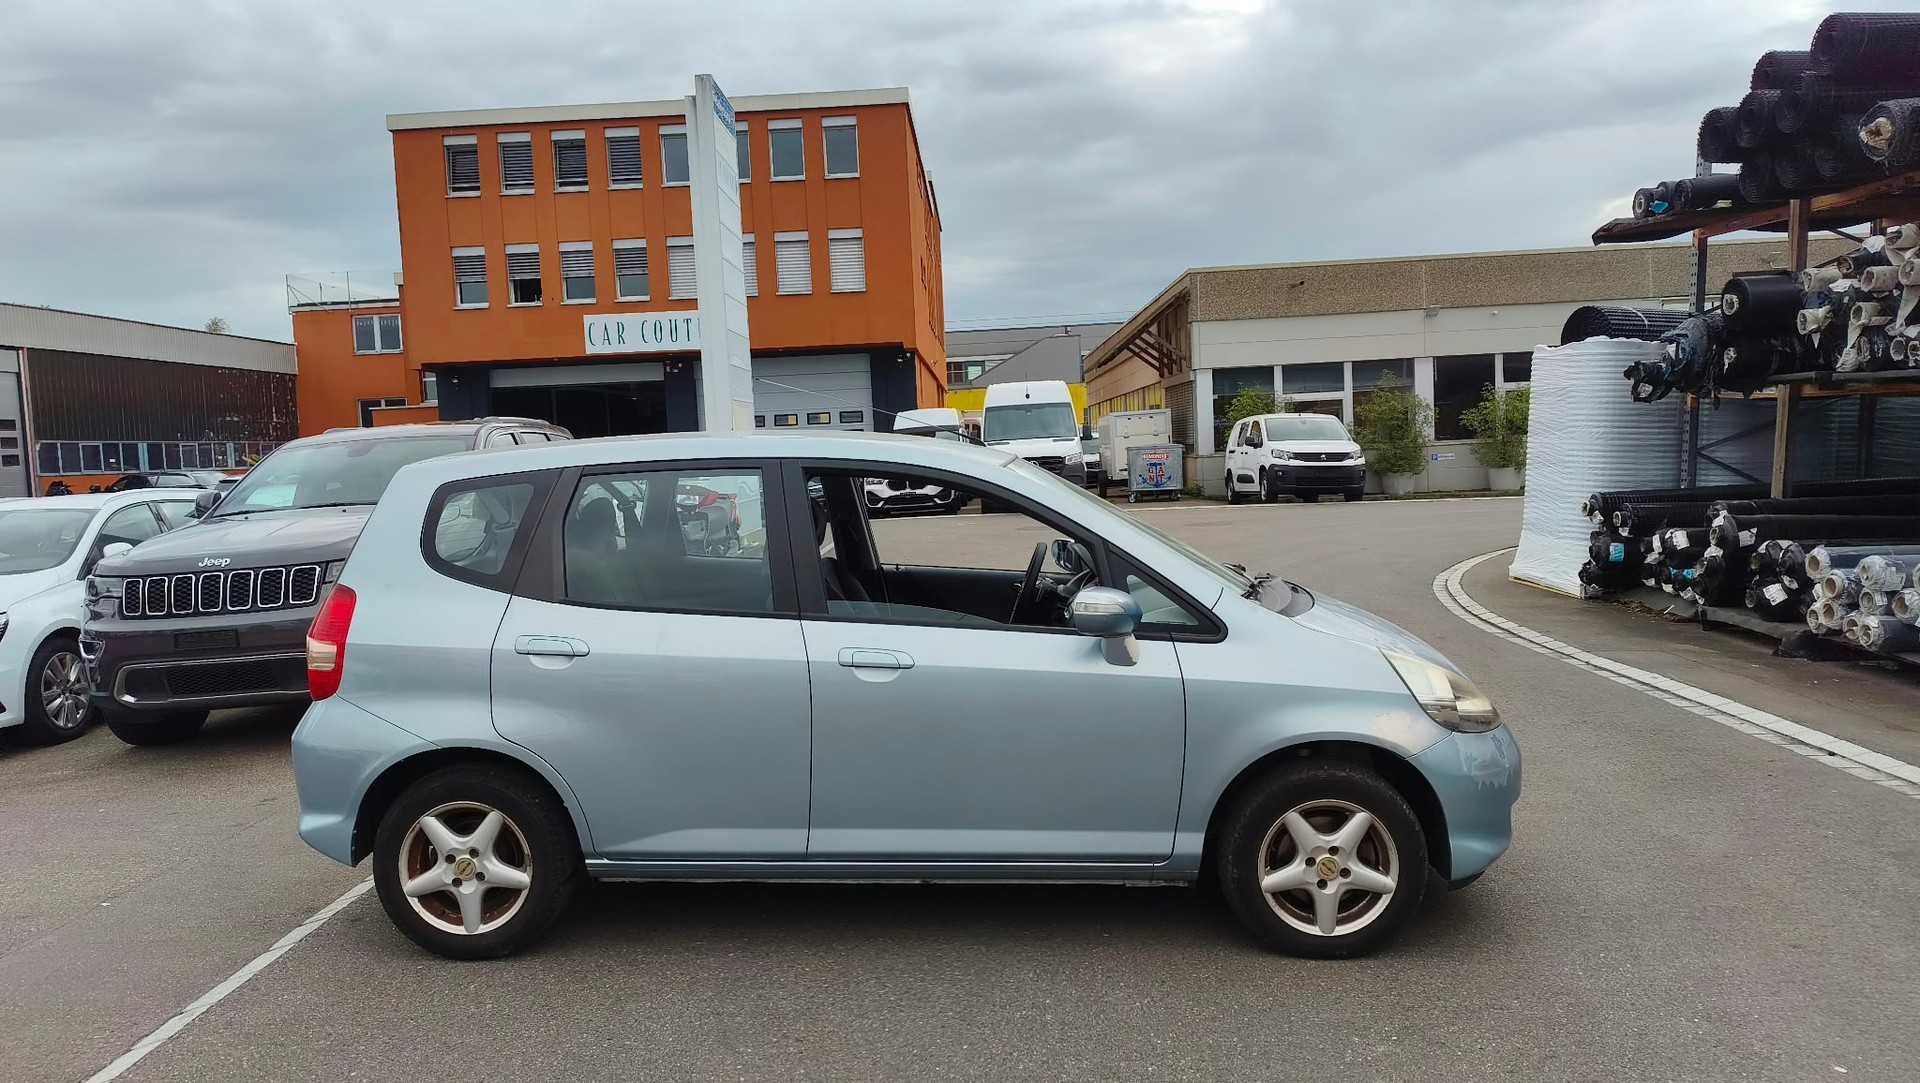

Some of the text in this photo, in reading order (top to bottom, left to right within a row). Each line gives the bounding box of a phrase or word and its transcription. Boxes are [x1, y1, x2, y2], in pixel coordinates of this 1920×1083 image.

[588, 317, 701, 347] CAR COUT
[198, 556, 231, 568] Jeep
